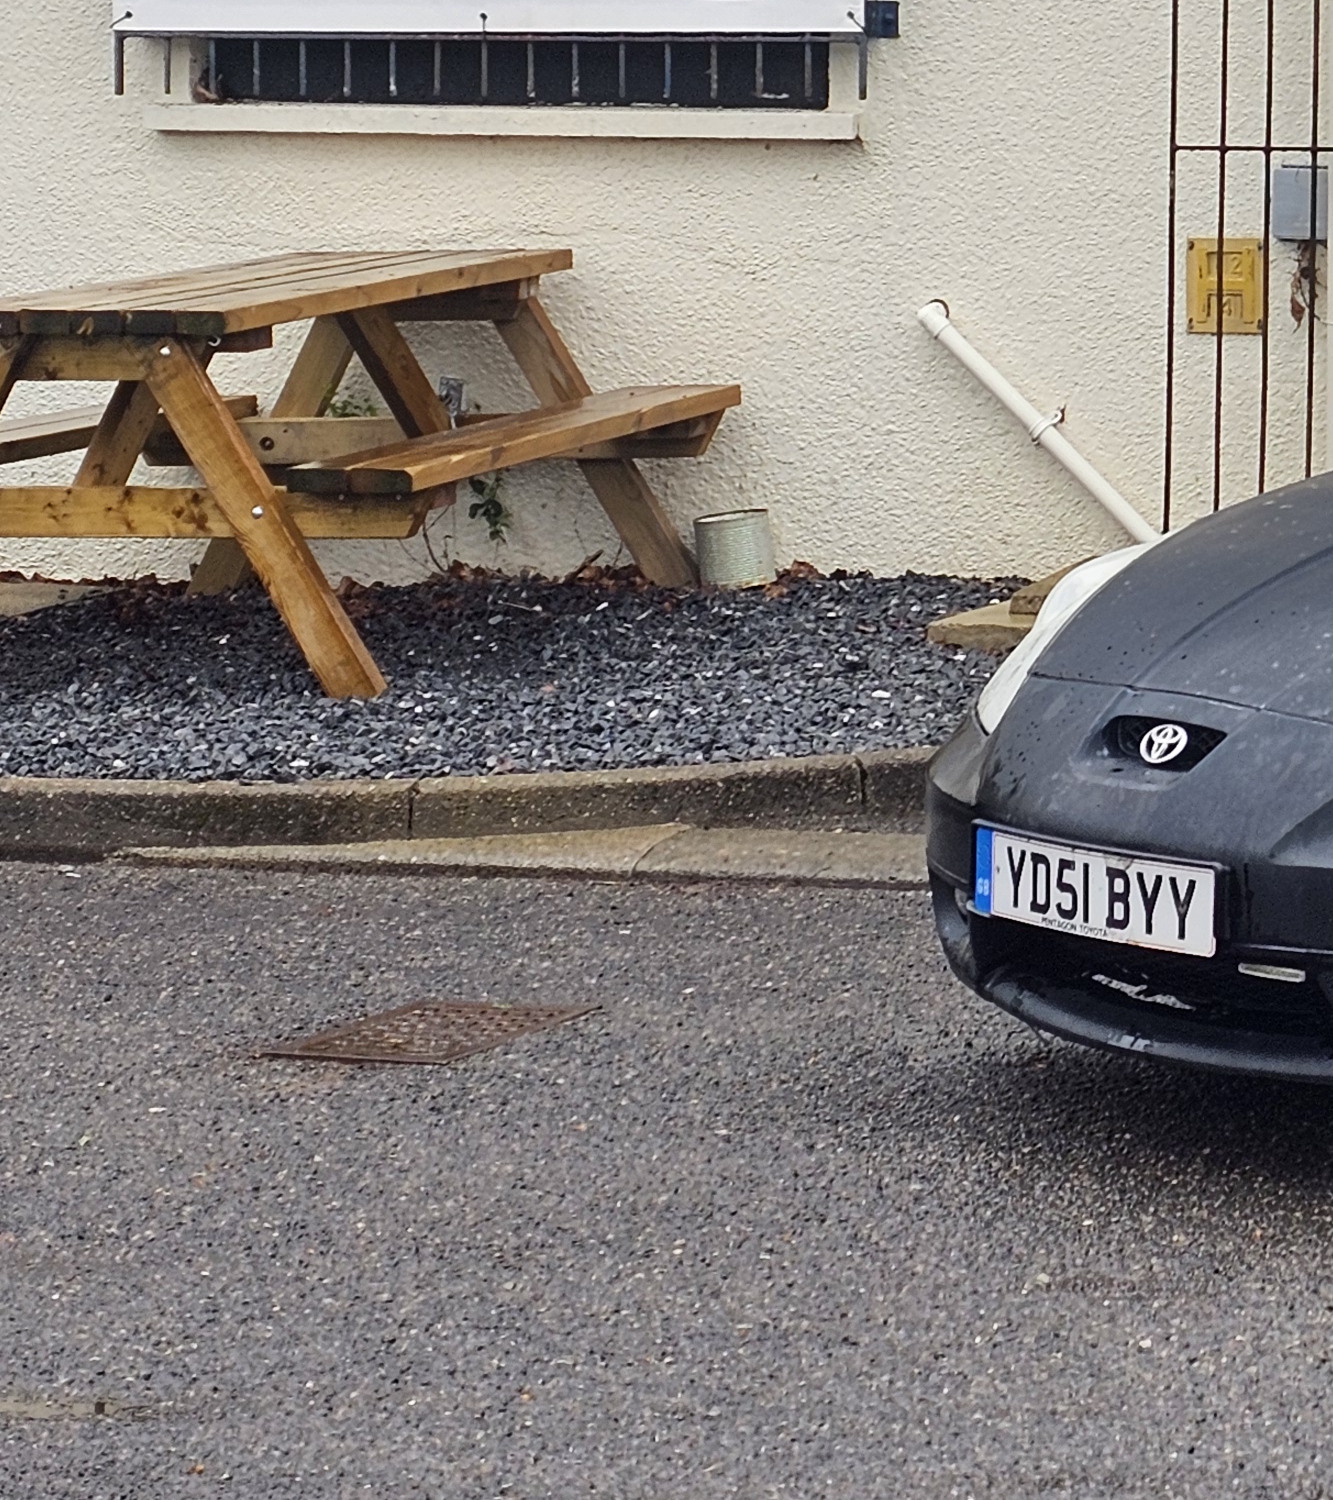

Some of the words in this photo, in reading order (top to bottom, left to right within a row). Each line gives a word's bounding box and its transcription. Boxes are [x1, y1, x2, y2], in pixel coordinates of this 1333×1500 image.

[1006, 846, 1091, 924] YD51
[1106, 866, 1197, 941] BYY
[1040, 917, 1077, 932] PENTAGON
[1079, 924, 1108, 937] TOYOTA
